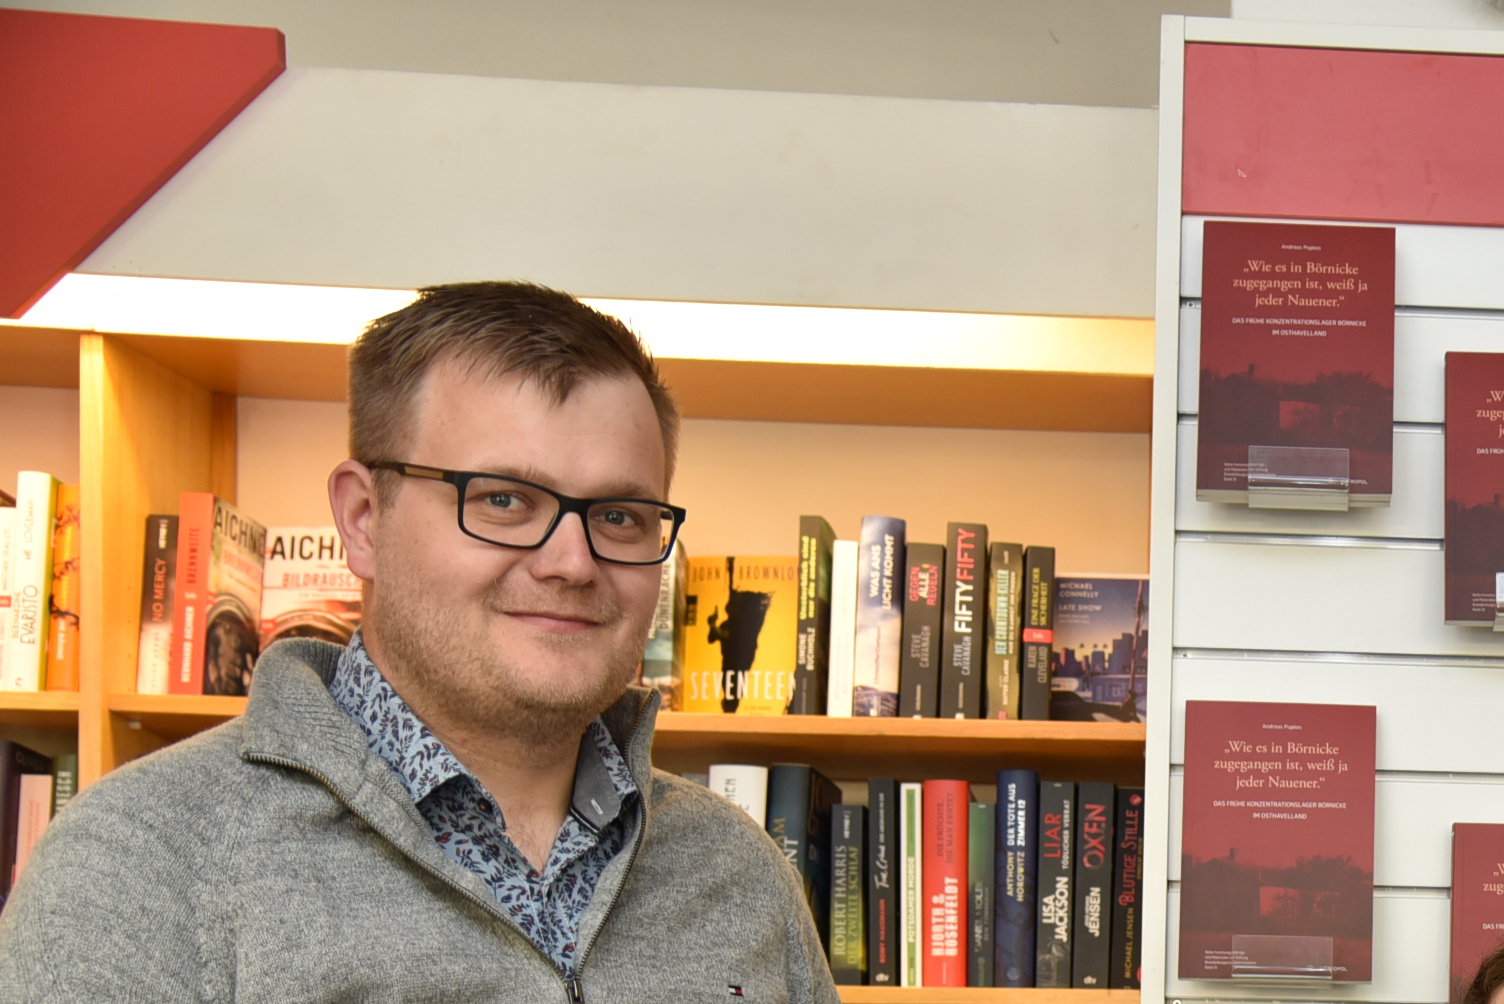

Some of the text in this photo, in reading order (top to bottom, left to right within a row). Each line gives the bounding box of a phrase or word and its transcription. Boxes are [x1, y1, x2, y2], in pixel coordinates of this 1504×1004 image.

[1233, 278, 1368, 293] zugegangen ist, weiß ja
[1243, 260, 1359, 275] „Wie es in Börnicke
[1255, 294, 1345, 308] jeder Nauener.“
[152, 558, 167, 622] NO MERCY
[869, 545, 881, 598] WAS ANS
[882, 534, 894, 611] LICHT KOMMT
[909, 567, 919, 601] GEGEN
[919, 570, 929, 598] ALLE
[927, 565, 938, 606] REGELN
[955, 528, 975, 633] FIFTY FIFTY
[19, 584, 38, 645] EVARISTO
[1008, 784, 1016, 800] AUS
[1017, 799, 1026, 846] ZIMMER 12
[1044, 814, 1061, 857] LIAR
[1083, 804, 1106, 868] OXEN
[1017, 852, 1025, 901] HOROWITZ
[1119, 810, 1138, 906] BLUTIGE STILLE
[932, 894, 944, 956] HJORTH &
[945, 877, 957, 956] ROSENFELDT
[1042, 894, 1055, 923] LISA
[1054, 877, 1068, 942] JACKSON
[1089, 887, 1101, 936] JENSEN
